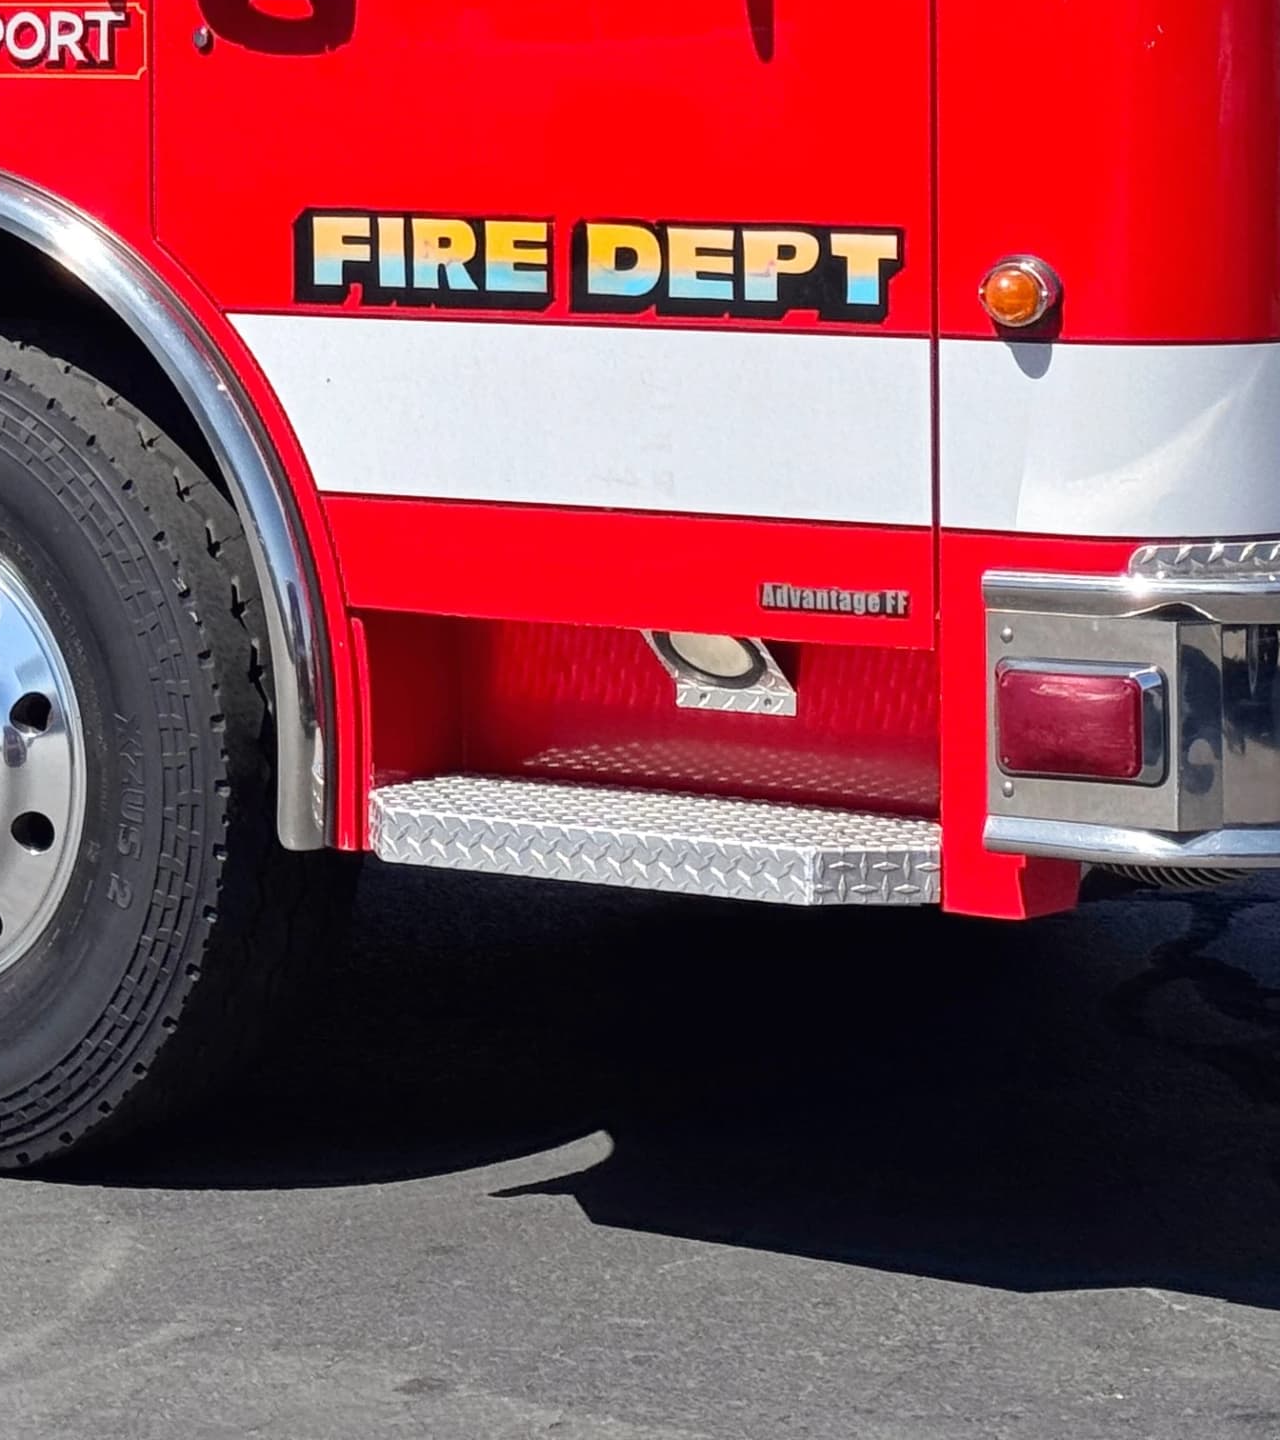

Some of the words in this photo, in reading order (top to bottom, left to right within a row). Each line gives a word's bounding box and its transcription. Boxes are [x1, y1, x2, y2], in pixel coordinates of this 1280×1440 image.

[311, 215, 549, 295] FIRE
[586, 222, 898, 306] DEPT
[761, 582, 880, 615] Advantage
[885, 591, 908, 614] FF
